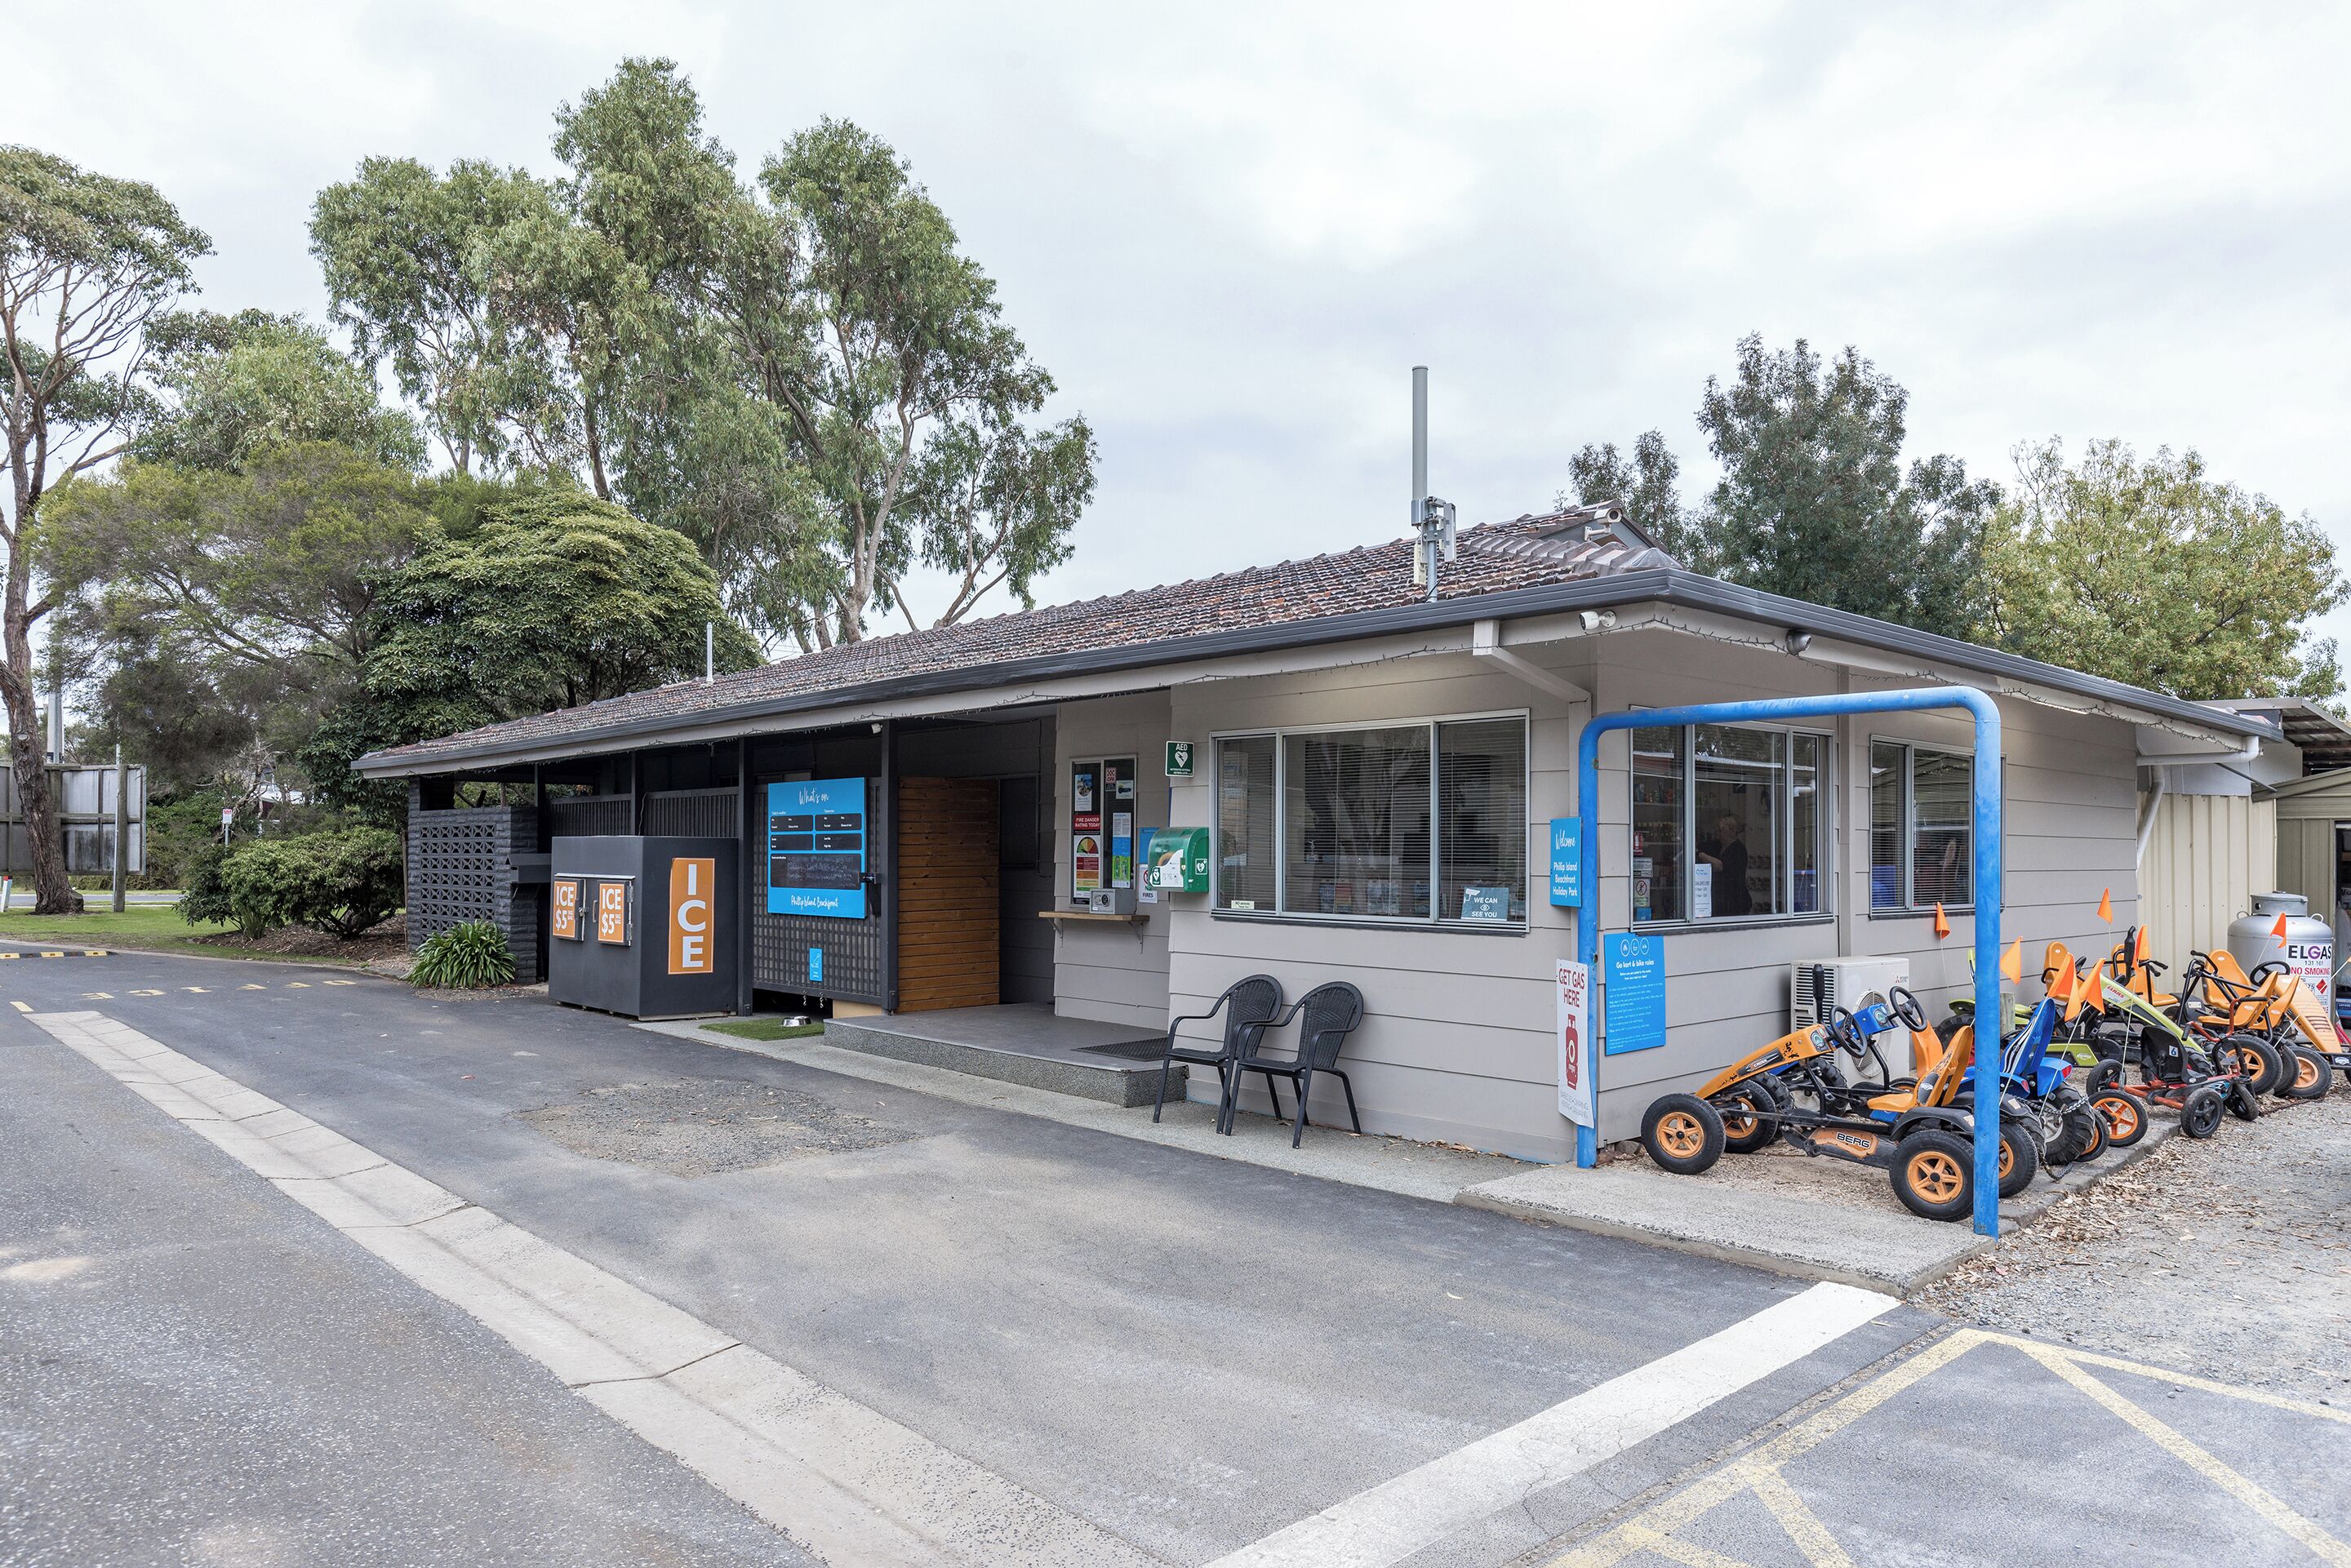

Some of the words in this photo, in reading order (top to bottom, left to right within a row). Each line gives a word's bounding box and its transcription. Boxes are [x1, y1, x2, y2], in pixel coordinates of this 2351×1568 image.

[1176, 743, 1188, 751] AED
[799, 786, 820, 805] What's
[820, 793, 829, 802] on
[1555, 828, 1575, 851] Welcome
[1553, 861, 1565, 873] Phillip
[1565, 861, 1578, 871] Island
[1555, 874, 1575, 883] Beachfront
[556, 886, 574, 907] ICE
[602, 888, 621, 910] ICE
[1553, 886, 1567, 898] Holiday
[1568, 886, 1578, 896] Park
[555, 908, 567, 931] $5
[601, 911, 615, 936] $5
[677, 864, 706, 968] ICE
[2287, 944, 2331, 960] ELGAS
[1558, 967, 1571, 986] GET
[1571, 971, 1585, 990] GAS
[2291, 966, 2303, 975] NO
[2304, 967, 2331, 975] SMOKING
[1563, 987, 1580, 1008] HERE
[2171, 1047, 2177, 1055] 6
[1837, 1132, 1870, 1148] BERG
